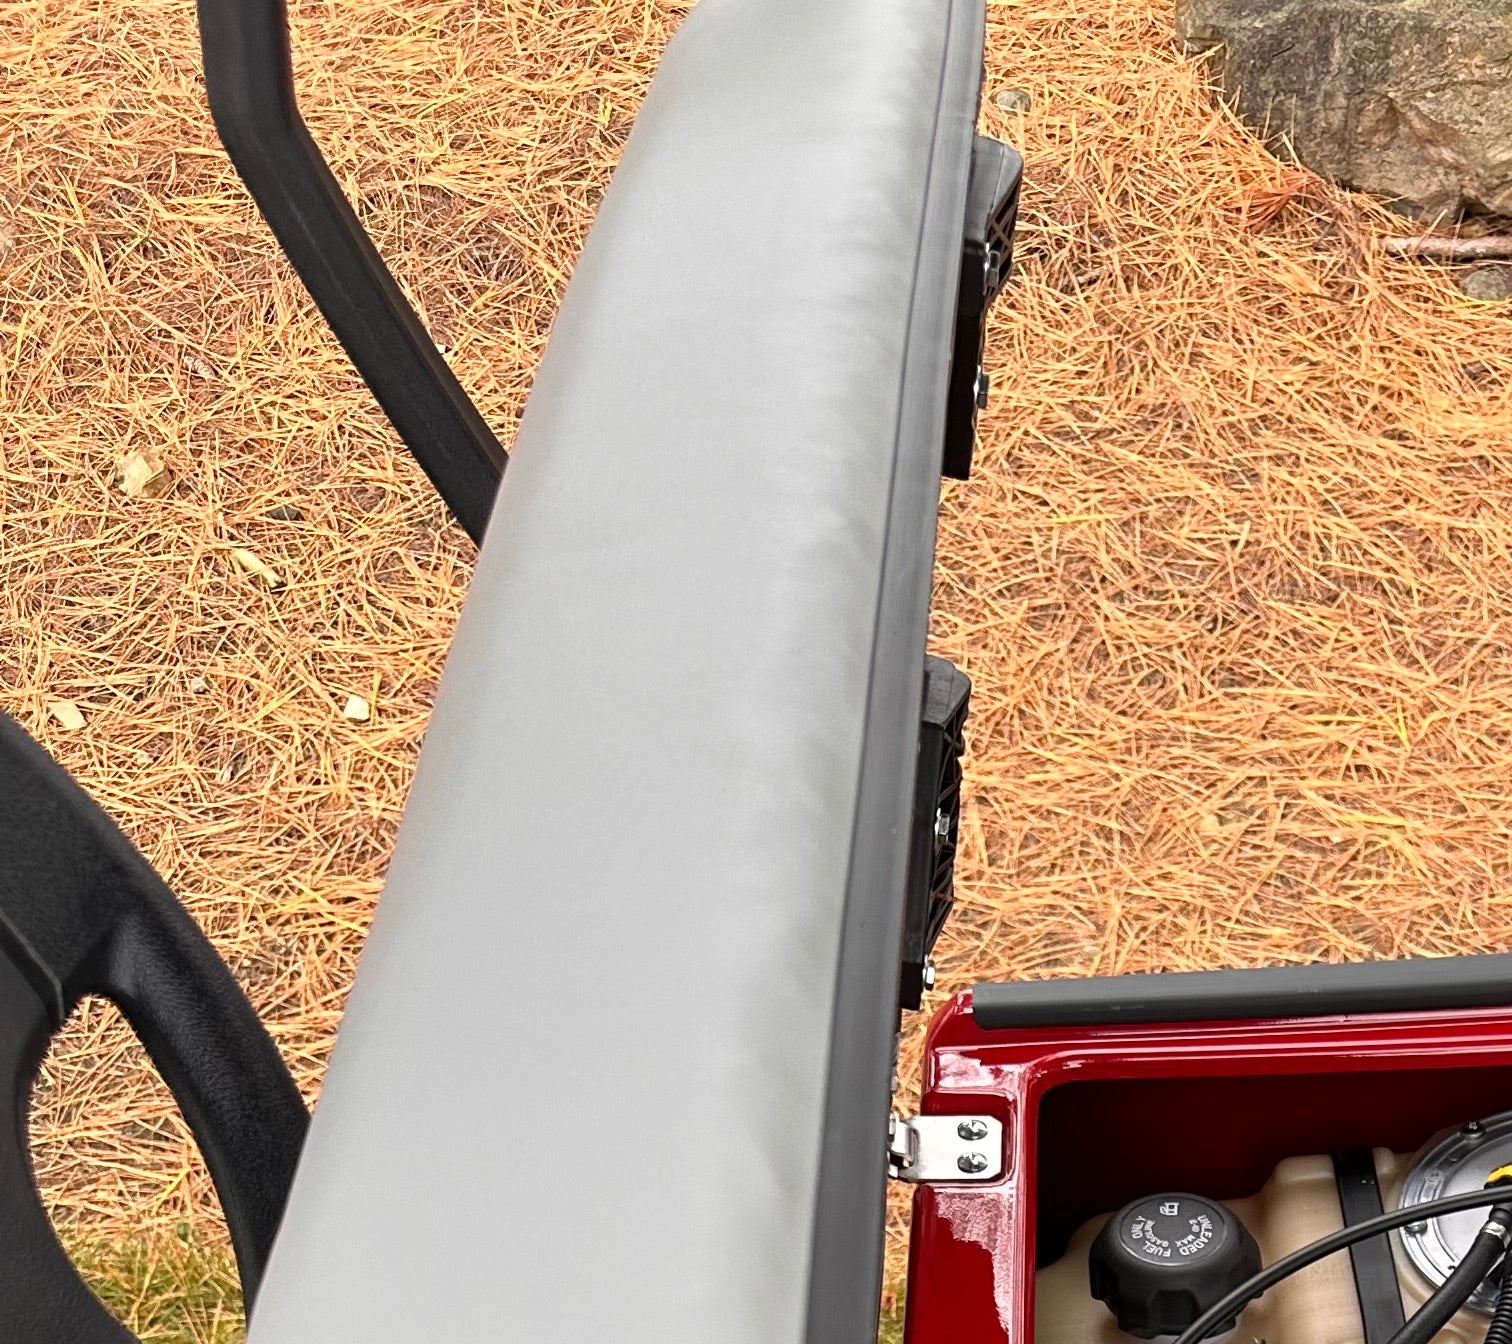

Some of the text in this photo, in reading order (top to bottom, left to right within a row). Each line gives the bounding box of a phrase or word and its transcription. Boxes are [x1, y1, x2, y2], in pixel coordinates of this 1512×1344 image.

[1131, 1214, 1214, 1257] UNLEADED FUEL ONLY
[1175, 1234, 1196, 1248] MAX
